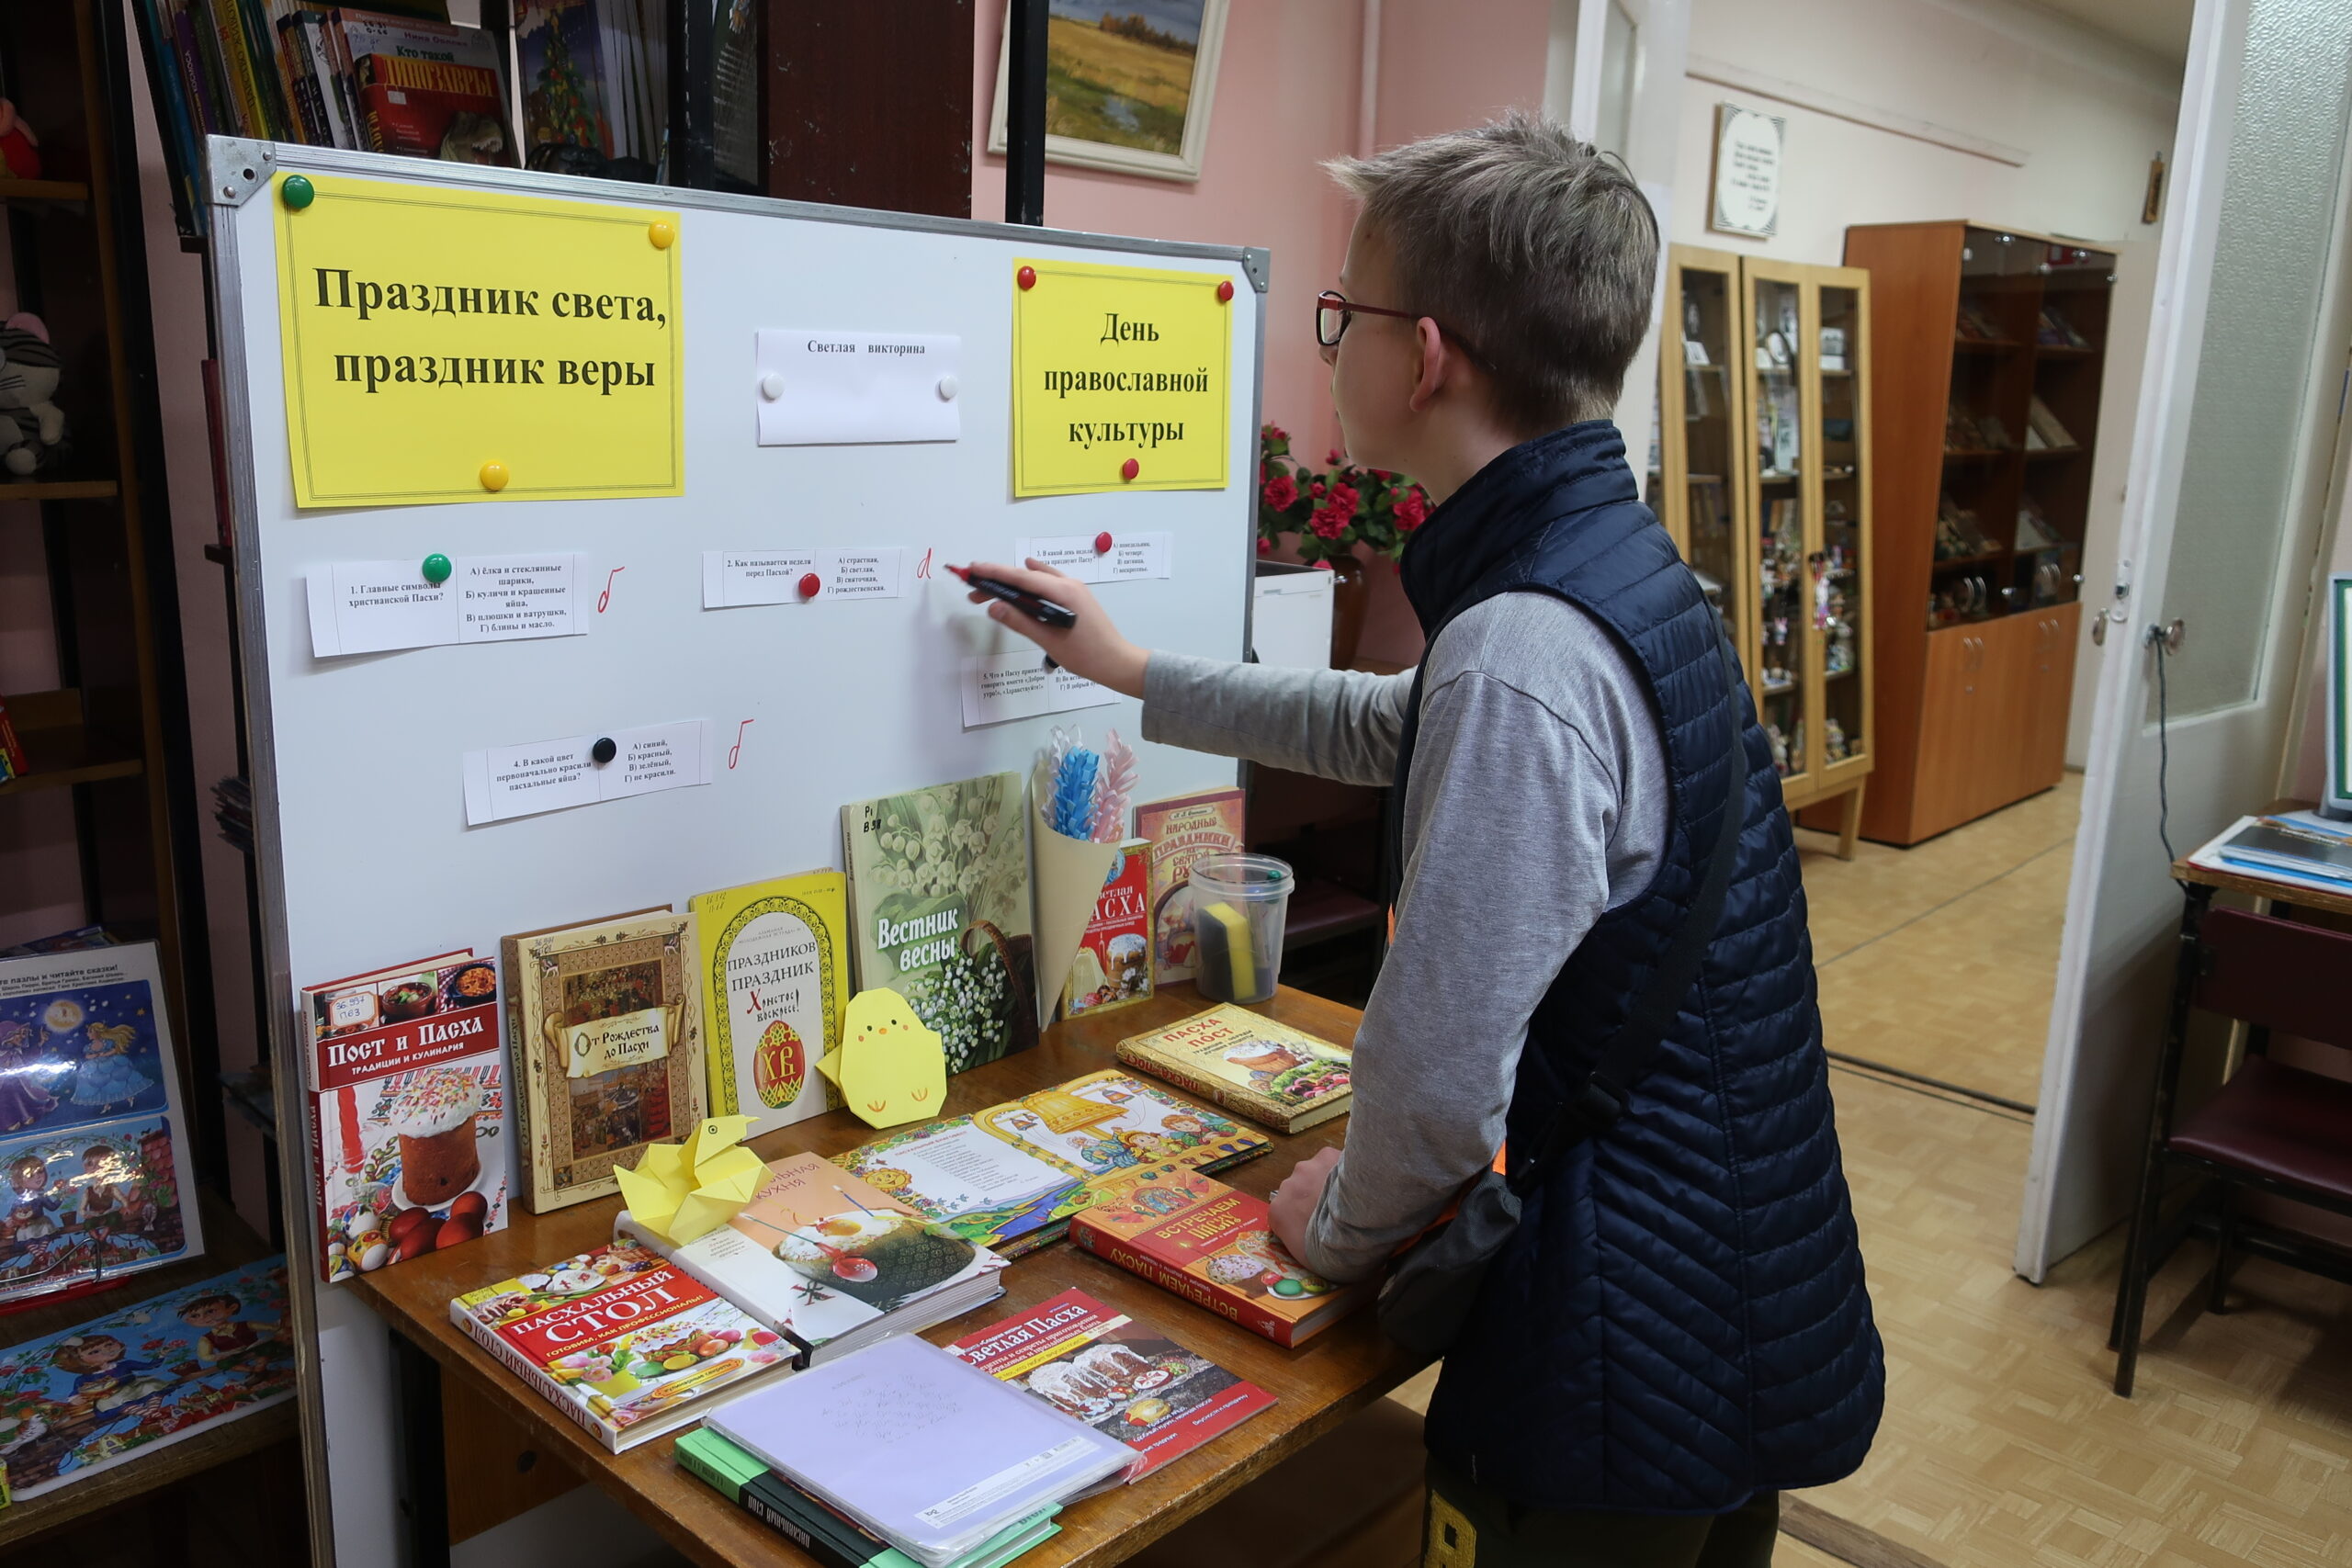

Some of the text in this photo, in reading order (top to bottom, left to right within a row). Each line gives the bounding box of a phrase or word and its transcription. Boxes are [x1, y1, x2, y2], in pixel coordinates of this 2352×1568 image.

[396, 45, 419, 58] Кто
[383, 58, 494, 97] ДИНОЗАВРЫ
[312, 267, 668, 330] Праздник света,
[1100, 312, 1160, 347] День
[807, 339, 926, 357] Светлая викторина
[334, 353, 656, 396] праздник веры
[1043, 367, 1210, 400] православной
[1068, 417, 1185, 449] культуры
[469, 563, 563, 577] А) ёлка и стеклянные
[727, 558, 812, 569] 2. Как называется неделя
[745, 567, 794, 578] перед Пасхой?
[849, 565, 876, 574] светлая,
[350, 580, 442, 596] 1. Главные символы
[465, 584, 567, 601] Б) куличи и крашенные
[498, 576, 535, 588] шарики,
[348, 591, 446, 608] христианской Пасхи?
[505, 599, 529, 610] яйца,
[466, 613, 477, 624] В)
[514, 612, 523, 620] и
[523, 608, 568, 622] ватрушки,
[480, 619, 556, 634] Г) блины и масло.
[628, 749, 673, 763] Б) красный,
[632, 739, 669, 752] А) синий,
[496, 761, 593, 784] первоначально красили
[514, 753, 575, 770] 4. В какой цвет
[628, 759, 672, 773] В) зелёный,
[508, 773, 582, 792] пасхальные яйца?
[624, 768, 676, 784] Г) не красили.
[1165, 817, 1217, 834] НАРОДНЫЕ
[1091, 893, 1146, 922] АСХА
[877, 907, 958, 950] Вестник
[728, 942, 817, 972] ПРАЗДНИКОВ
[899, 935, 956, 972] весны
[49, 968, 85, 980] читайте
[86, 964, 119, 976] сказки!
[732, 961, 814, 992] ПРАЗДНИК
[574, 1024, 660, 1057] От Рождества
[1162, 1017, 1224, 1043] ПАСХА
[1187, 1026, 1236, 1048] ПОСТ
[328, 1016, 484, 1067] Пост и Пасха
[604, 1039, 650, 1061] до Пасхи
[352, 1042, 464, 1076] ТРАДИЦИИ И КУЛИНАРИЯ
[762, 1045, 796, 1083] ХВ
[1124, 1054, 1200, 1092] ПАСХА ПОСТ
[755, 1179, 807, 1200] КУХНЯ
[1154, 1198, 1241, 1240] ВСТРЕЧАЕМ
[1110, 1247, 1238, 1320] ВСТРЕЧАЕМ ПАСХУ
[513, 1269, 676, 1336] ПАСХАЛЬНЫЙ
[546, 1285, 682, 1343] СТОЛ
[1023, 1304, 1089, 1335] Пасха
[546, 1294, 704, 1359] ГОТОВИМ, КАК ПРОФЕССИОНАЛЫ!
[979, 1355, 1009, 1371] ецепты
[474, 1325, 585, 1427] ПАСХАЛЬНЫЙ СТОЛ
